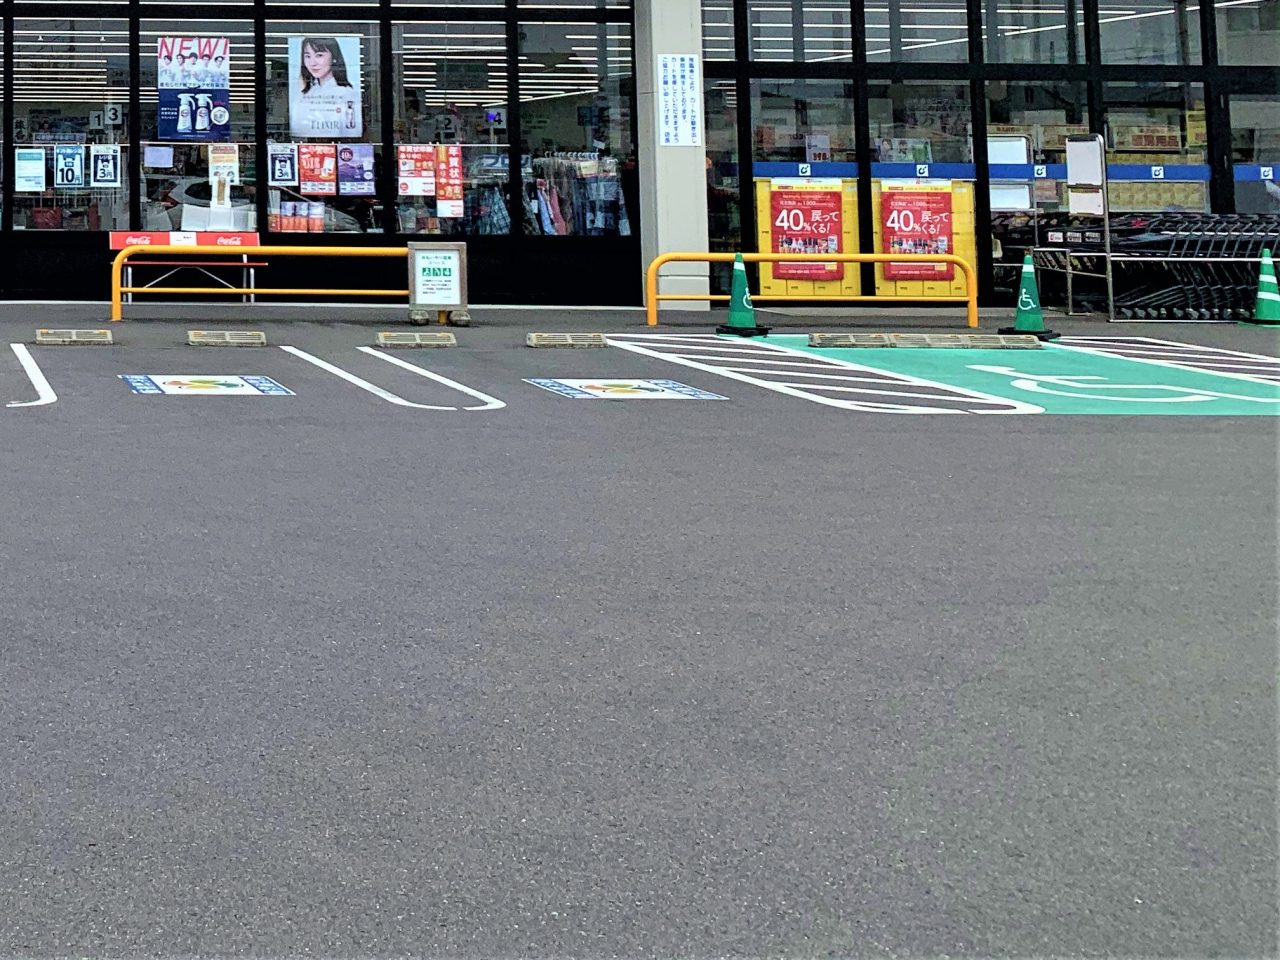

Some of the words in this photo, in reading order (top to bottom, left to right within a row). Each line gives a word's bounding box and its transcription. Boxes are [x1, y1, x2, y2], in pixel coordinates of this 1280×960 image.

[311, 120, 340, 130] ELIXIR
[775, 208, 812, 231] 40%
[811, 209, 840, 222] 戻って
[886, 210, 922, 232] 40%
[921, 210, 950, 223] 戻って
[126, 236, 151, 245] Coca-Cola
[217, 236, 242, 245] Coca-Cola
